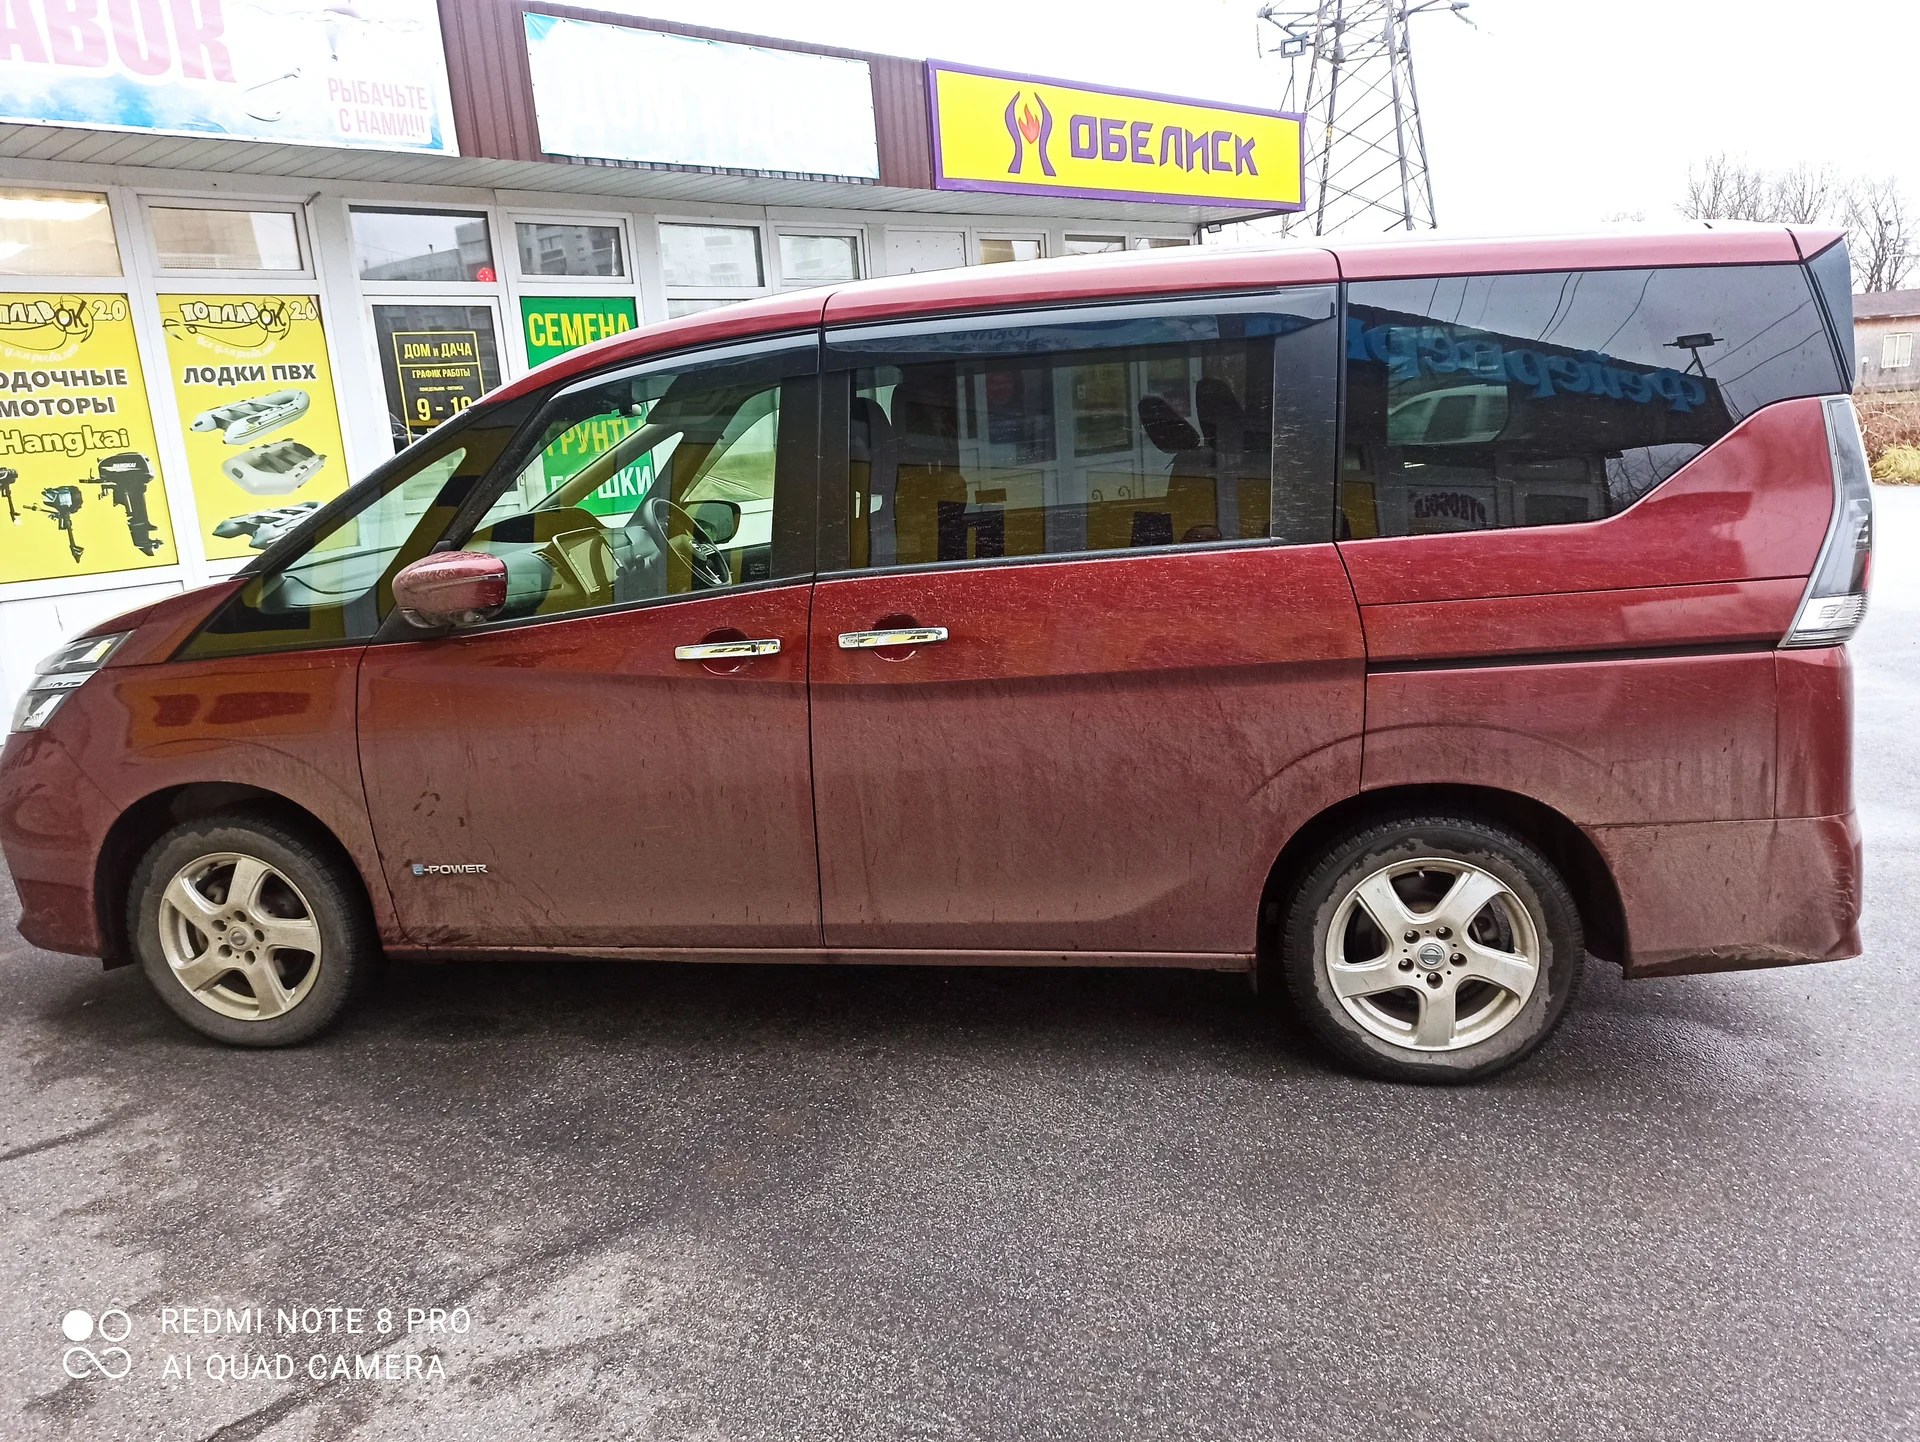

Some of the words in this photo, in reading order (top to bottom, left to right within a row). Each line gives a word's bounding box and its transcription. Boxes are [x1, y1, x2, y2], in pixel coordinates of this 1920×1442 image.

[327, 77, 428, 110] РЫБАЧЬТЕ
[339, 108, 351, 132] С
[355, 109, 425, 137] НАМИ!!!
[1070, 114, 1258, 176] ОБЕЛИСК
[92, 300, 126, 321] 2.0
[289, 301, 319, 321] 2.0
[404, 343, 431, 359] ДОМ
[441, 343, 472, 358] ДАЧА
[183, 365, 264, 386] ЛОДКИ
[271, 364, 317, 381] ПВХ
[412, 369, 442, 379] ГРАФИК
[442, 368, 471, 378] РАБОТЫ
[0, 397, 115, 417] МОТОРЫ
[417, 398, 431, 421] 9
[0, 425, 130, 457] Hangkai
[551, 466, 652, 500] ГШКИ
[412, 864, 488, 875] e-POWER
